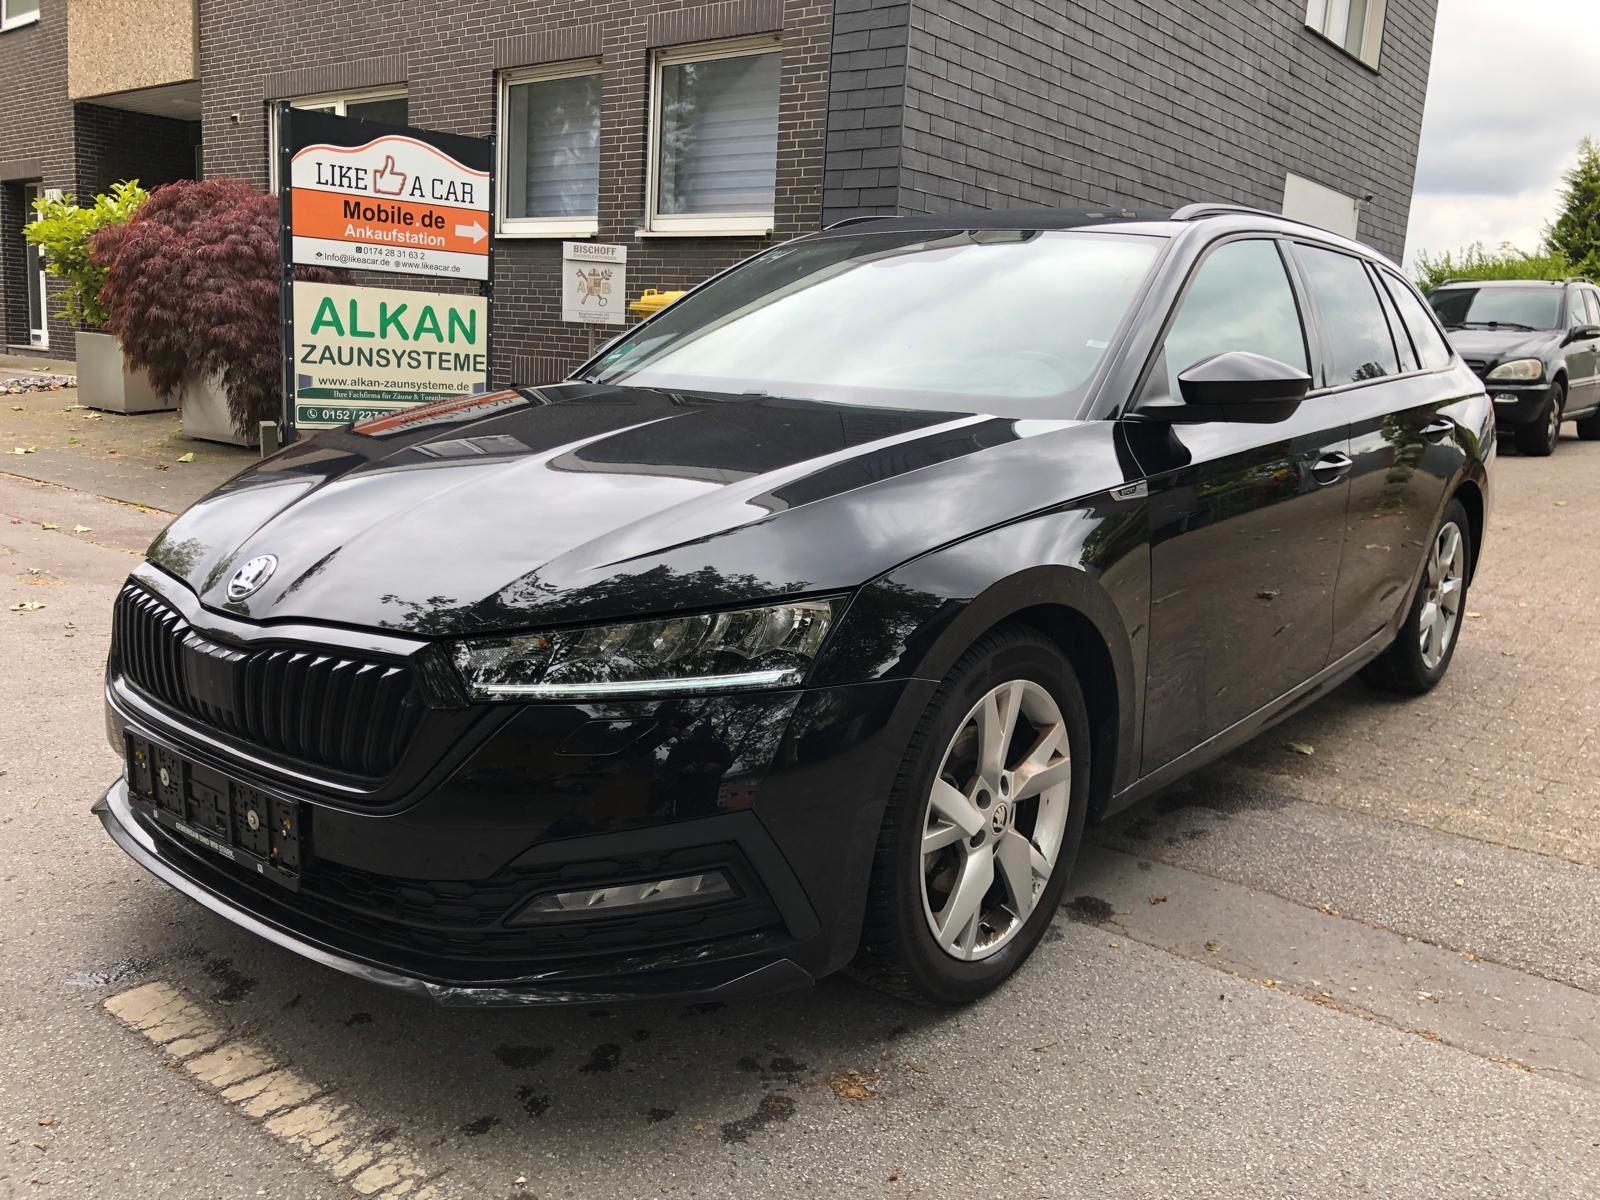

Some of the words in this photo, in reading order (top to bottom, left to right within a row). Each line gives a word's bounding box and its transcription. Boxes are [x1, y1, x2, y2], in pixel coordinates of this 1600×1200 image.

[316, 162, 368, 190] LIKE
[409, 176, 426, 198] A
[431, 178, 475, 204] CAR
[343, 200, 446, 229] Mobile.de
[344, 224, 446, 246] Ankaufstation
[363, 247, 383, 256] 0174
[385, 249, 396, 258] 28
[397, 250, 407, 259] 31
[409, 250, 419, 259] 63
[420, 251, 426, 260] 2
[573, 245, 617, 256] BISCHOFF
[324, 253, 390, 266] Info@likeacar.de
[401, 261, 461, 273] www.likeacar.de
[310, 296, 477, 345] ALKAN
[300, 344, 486, 373] ZAUNSYSTEME
[318, 376, 470, 392] www.alkan-zaunsysteme.de
[333, 390, 348, 398] Ihre
[349, 391, 381, 399] Fachfirma
[322, 409, 350, 420] 0152
